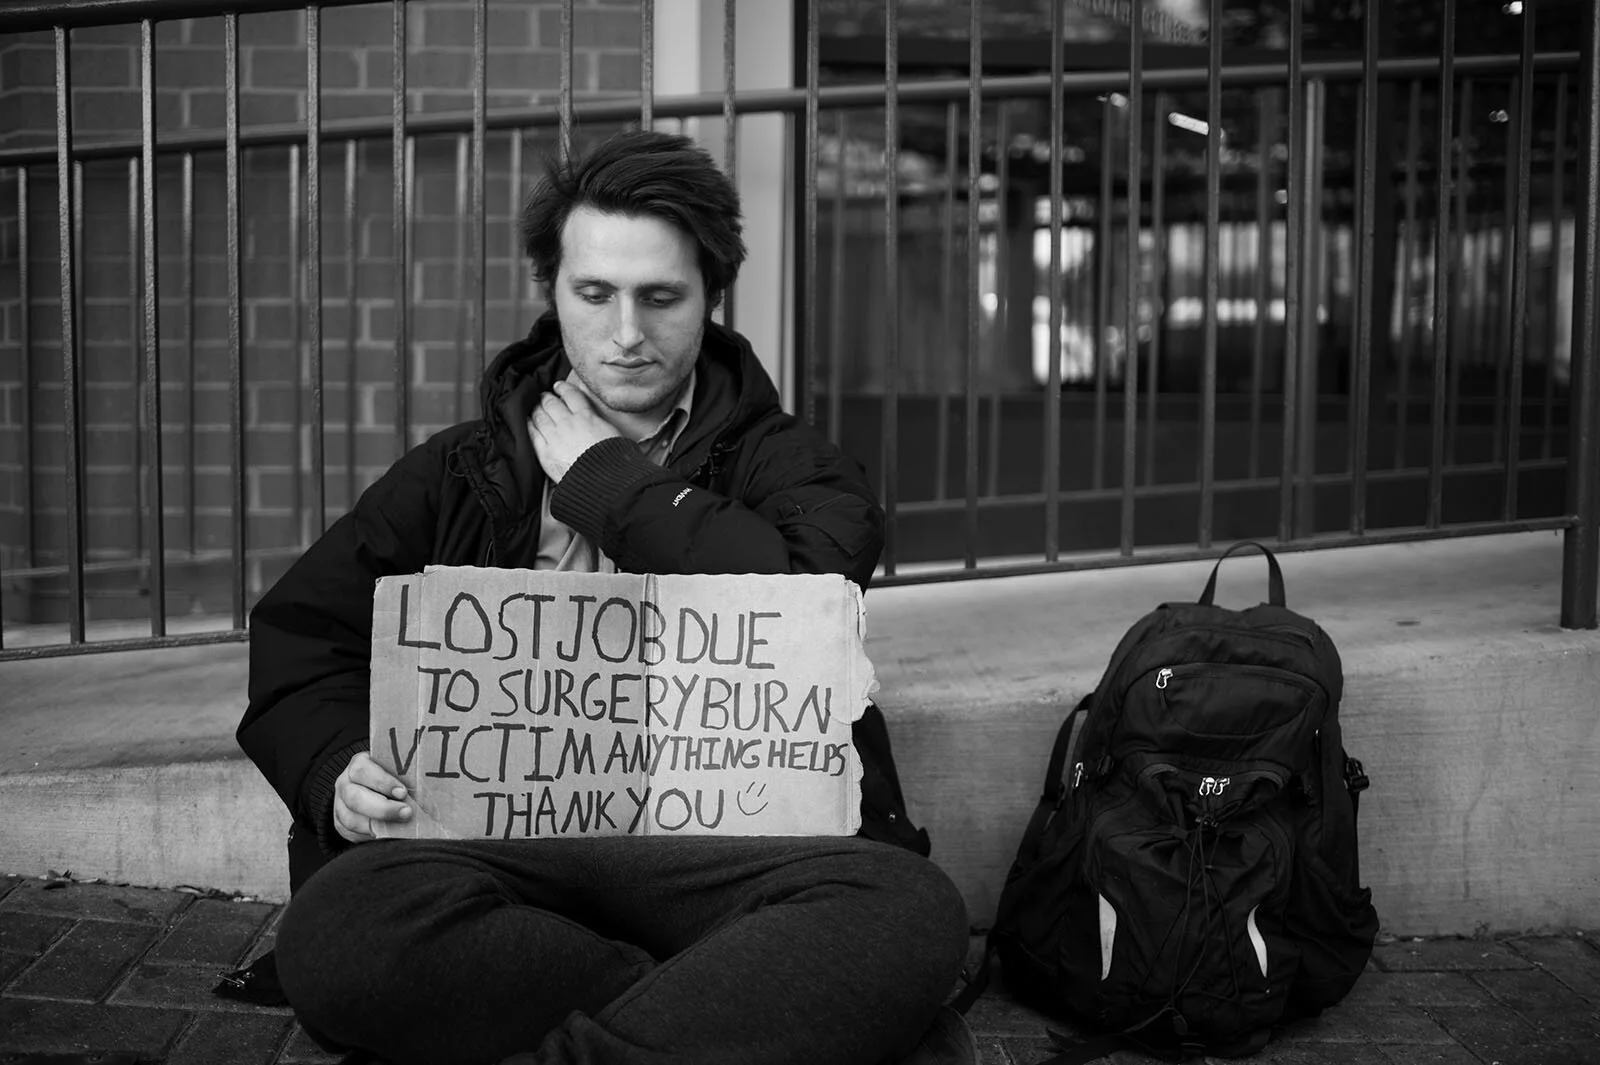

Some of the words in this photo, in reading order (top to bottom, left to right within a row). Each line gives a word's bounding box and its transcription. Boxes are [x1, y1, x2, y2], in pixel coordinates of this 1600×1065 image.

[398, 583, 556, 661] LOST
[556, 595, 667, 666] JOB
[676, 607, 782, 670] DUE
[417, 665, 480, 714] TO
[491, 668, 700, 731] SURGERY
[700, 677, 832, 735] BURN
[389, 722, 596, 783] VICTIM
[603, 731, 762, 777] ANYTHING
[767, 738, 849, 777] HELPS
[473, 786, 617, 840] THANK
[626, 787, 725, 834] YOU
